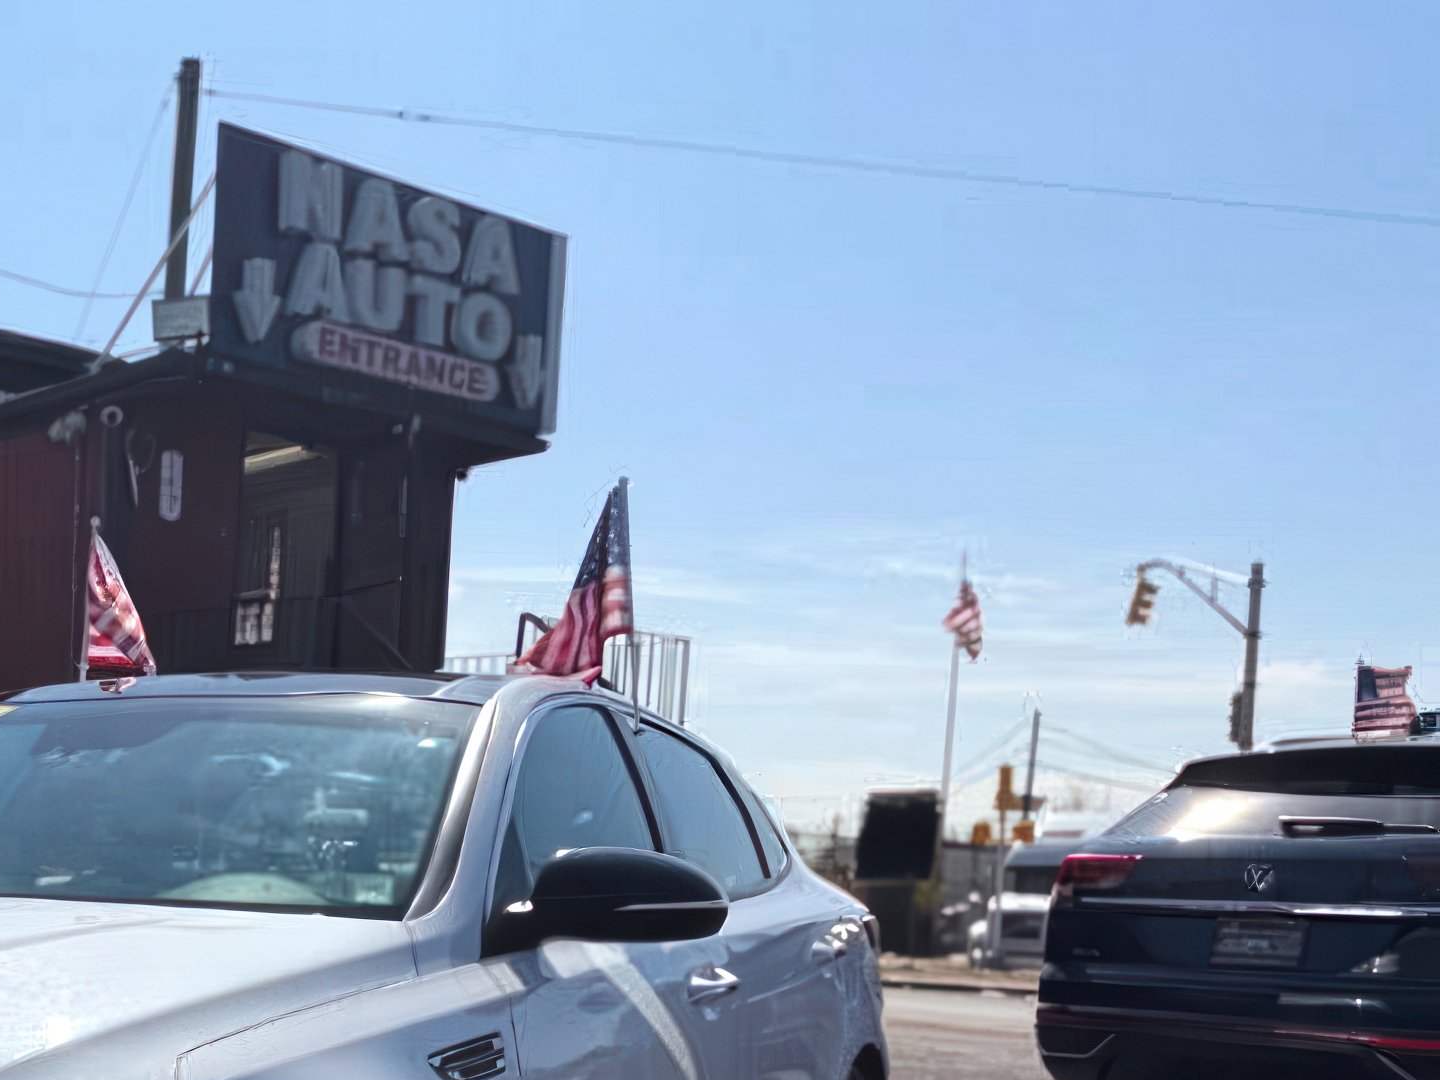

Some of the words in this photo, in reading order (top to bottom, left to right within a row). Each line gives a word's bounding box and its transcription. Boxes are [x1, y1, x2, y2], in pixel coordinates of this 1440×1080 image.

[278, 149, 520, 295] NASA
[284, 241, 513, 362] AUTO
[317, 327, 489, 396] ENTRANCE
